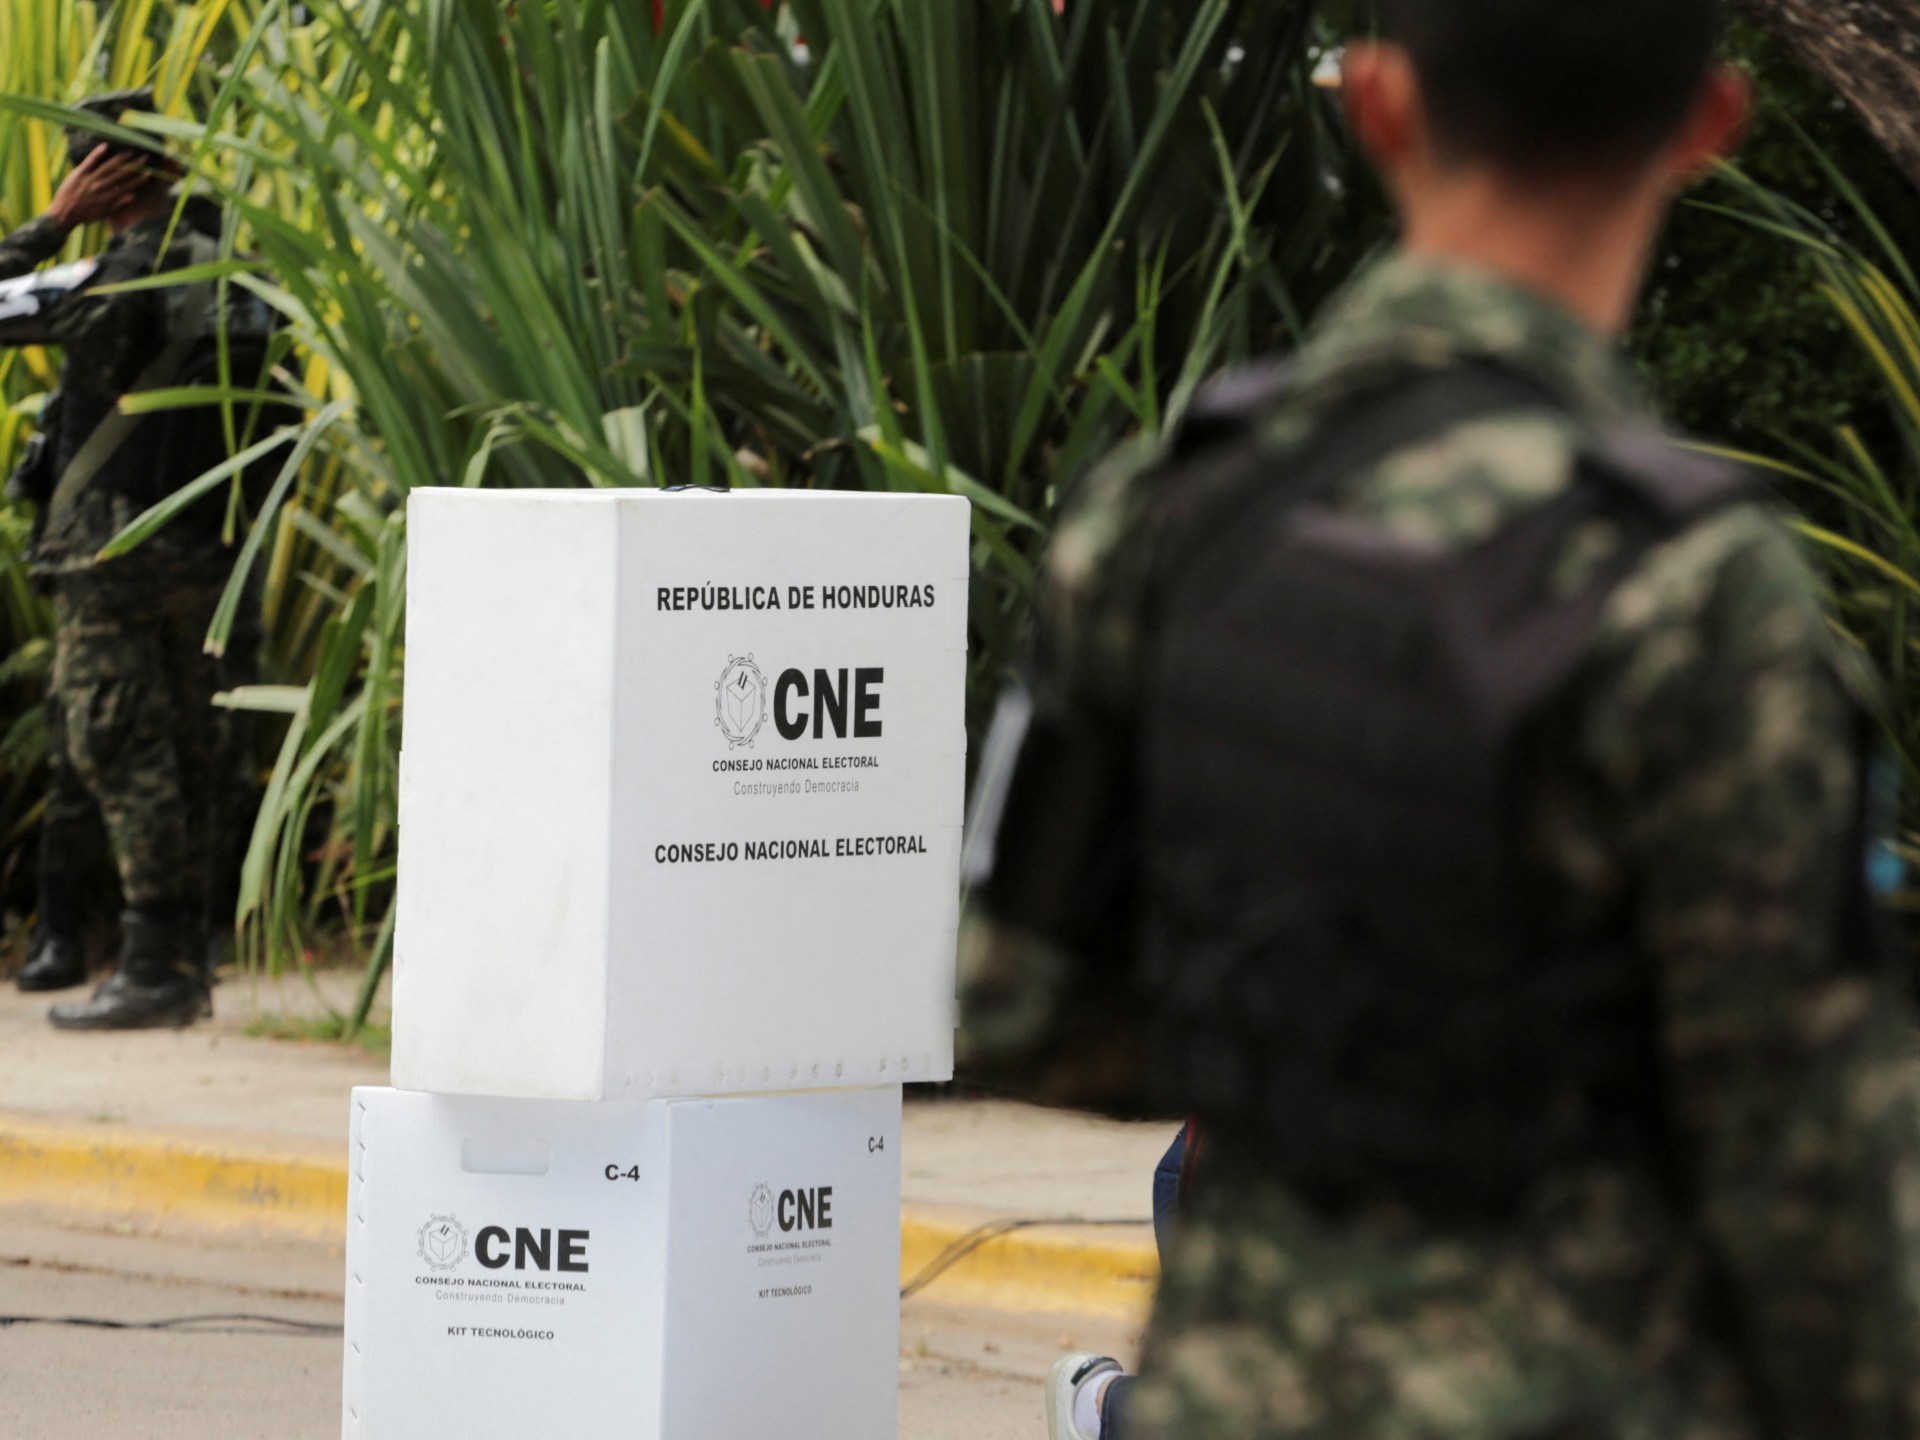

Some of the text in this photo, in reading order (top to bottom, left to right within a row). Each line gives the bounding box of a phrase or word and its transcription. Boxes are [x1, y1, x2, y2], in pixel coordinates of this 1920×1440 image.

[657, 581, 935, 611] REPÚBLICA DE HONDURAS
[773, 667, 885, 741] CNE
[712, 755, 879, 772] CONSEJO NACIONAL ELECTORAL
[733, 779, 860, 798] Construyendo Democracia
[654, 835, 928, 864] CONSEJO NACIONAL ELECTORAL
[868, 1135, 885, 1153] C-4
[604, 1163, 641, 1182] C-4
[777, 1186, 833, 1233] CNE
[474, 1225, 590, 1273] CNE
[747, 1239, 832, 1253] CONSEJO NACIONAL ELECTORAL
[415, 1276, 587, 1292] CONSEJO NACIONAL ELECTORAL
[758, 1285, 812, 1299] KIT TECNOLÓGICO
[435, 1290, 566, 1305] Construyendo Democracia
[447, 1326, 555, 1340] KIT TECNOLÓGICO
